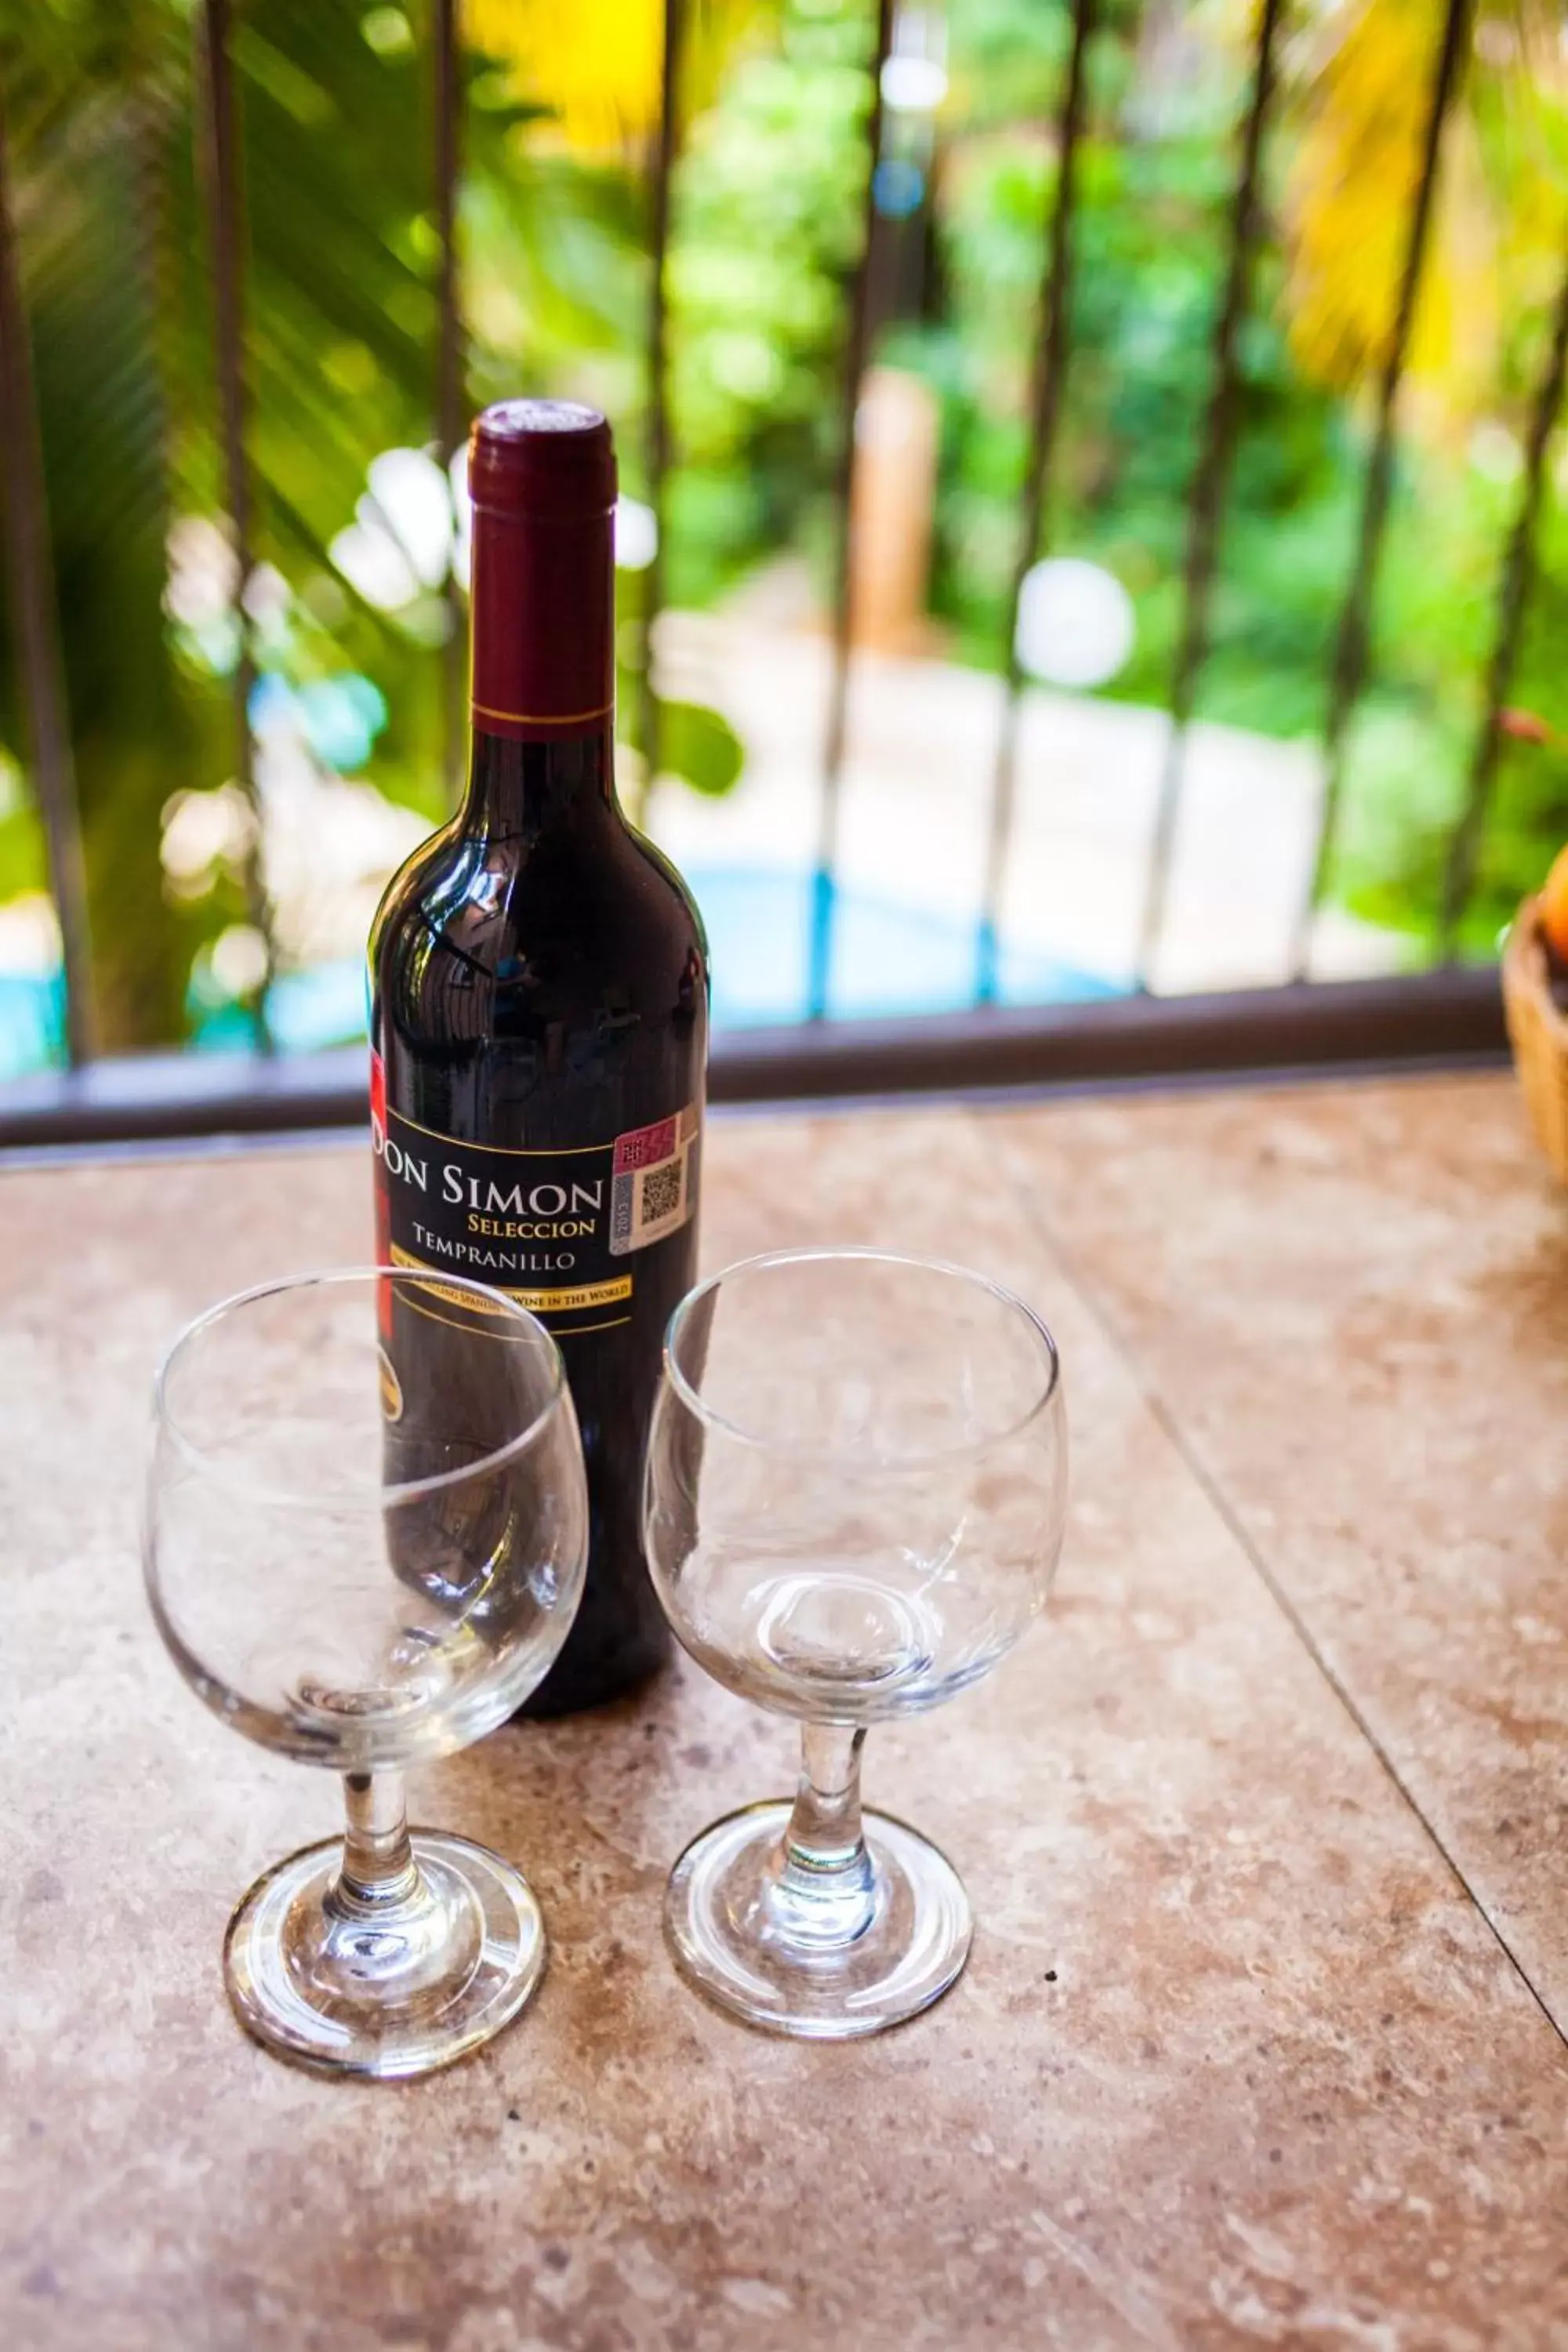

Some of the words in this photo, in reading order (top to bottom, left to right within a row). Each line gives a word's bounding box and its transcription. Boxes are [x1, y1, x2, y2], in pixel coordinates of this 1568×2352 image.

[371, 1110, 428, 1192] DON
[443, 1165, 604, 1215] SIMON
[468, 1213, 596, 1239] SELECCION
[412, 1221, 575, 1270] TEMPRANILLO
[548, 1295, 561, 1305] IN
[564, 1294, 586, 1305] THE
[590, 1283, 628, 1301] WORLD
